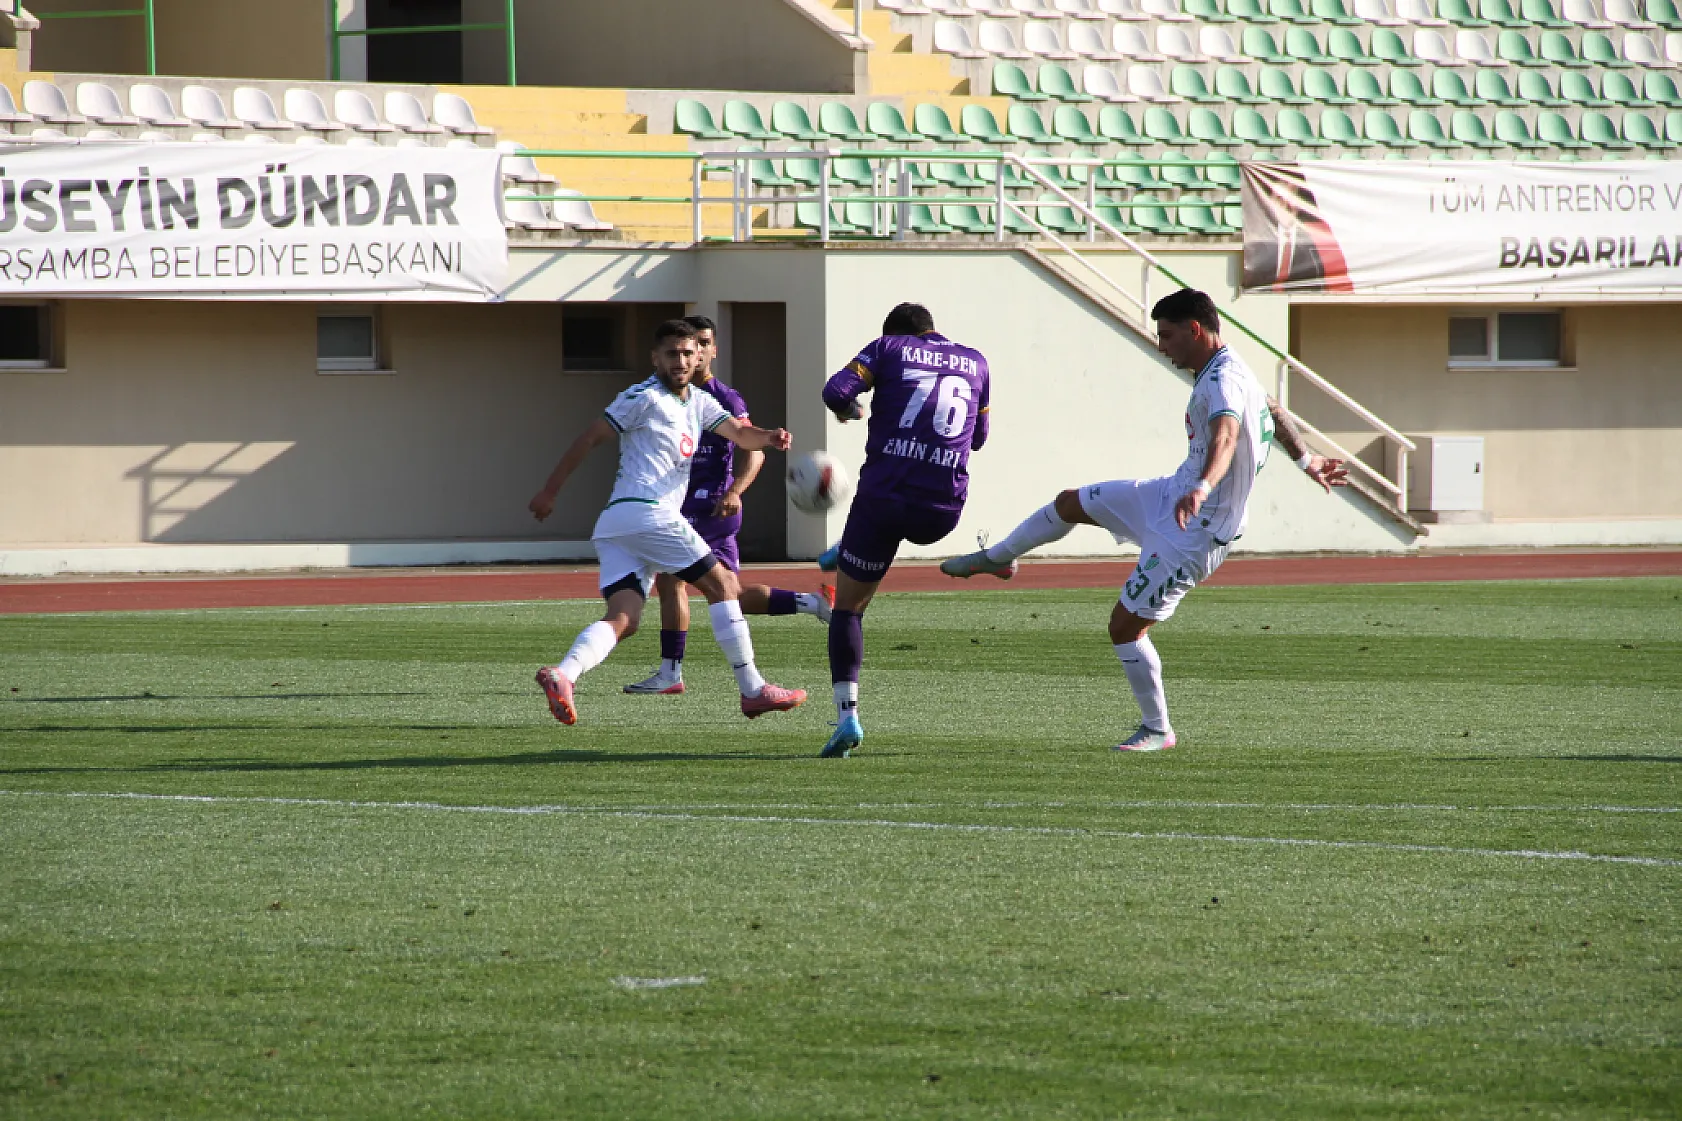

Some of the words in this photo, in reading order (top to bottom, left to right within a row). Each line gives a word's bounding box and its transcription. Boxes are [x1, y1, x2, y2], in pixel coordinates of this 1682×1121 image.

[216, 163, 459, 229] DÜNDAR
[1427, 177, 1485, 213] TÜM
[1496, 175, 1656, 212] ANTRENÖR
[150, 238, 308, 278] BELEDİYE
[321, 240, 463, 279] BAŞKANI
[901, 345, 977, 377] KARE-PEN
[898, 368, 972, 438] 76
[882, 436, 928, 460] EMİN
[928, 447, 962, 469] ARI
